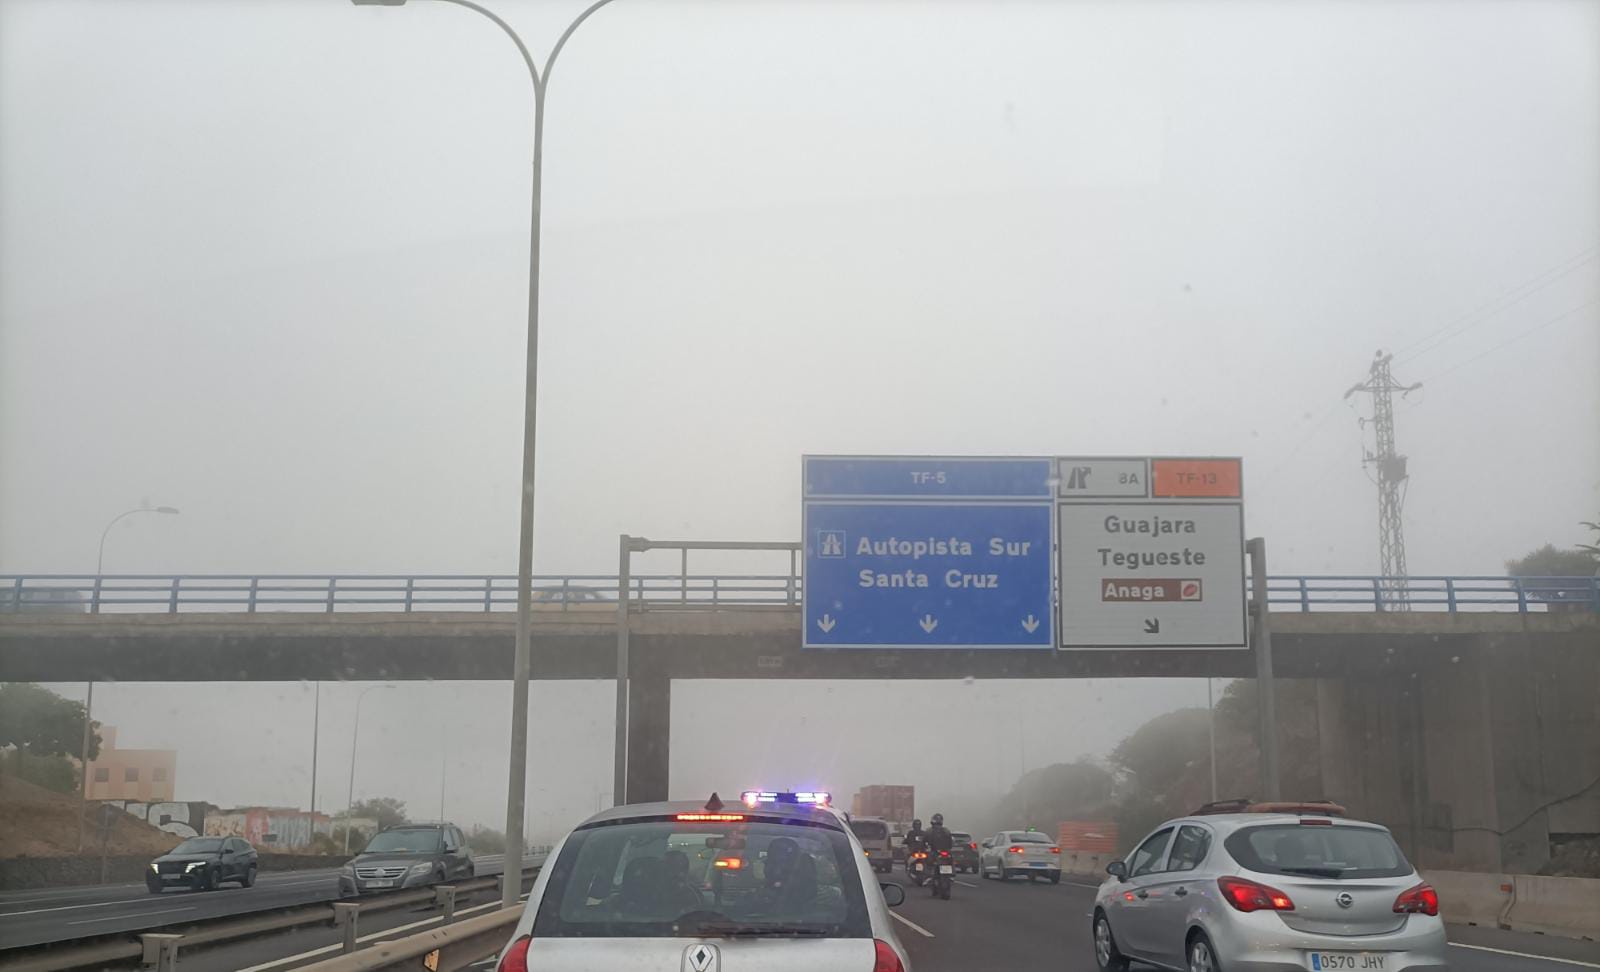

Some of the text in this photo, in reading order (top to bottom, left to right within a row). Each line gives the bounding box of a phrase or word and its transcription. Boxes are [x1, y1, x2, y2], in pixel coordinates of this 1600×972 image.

[910, 471, 946, 484] TF-5
[1118, 473, 1140, 485] 8A
[1176, 473, 1218, 485] TF-13
[1104, 515, 1196, 538] Guajara
[856, 536, 1031, 559] Autopista Sur
[1097, 548, 1206, 570] Tegueste
[859, 569, 998, 588] Santa Cruz
[1104, 583, 1165, 600] Anaga
[1321, 955, 1384, 969] 0570 JHY
